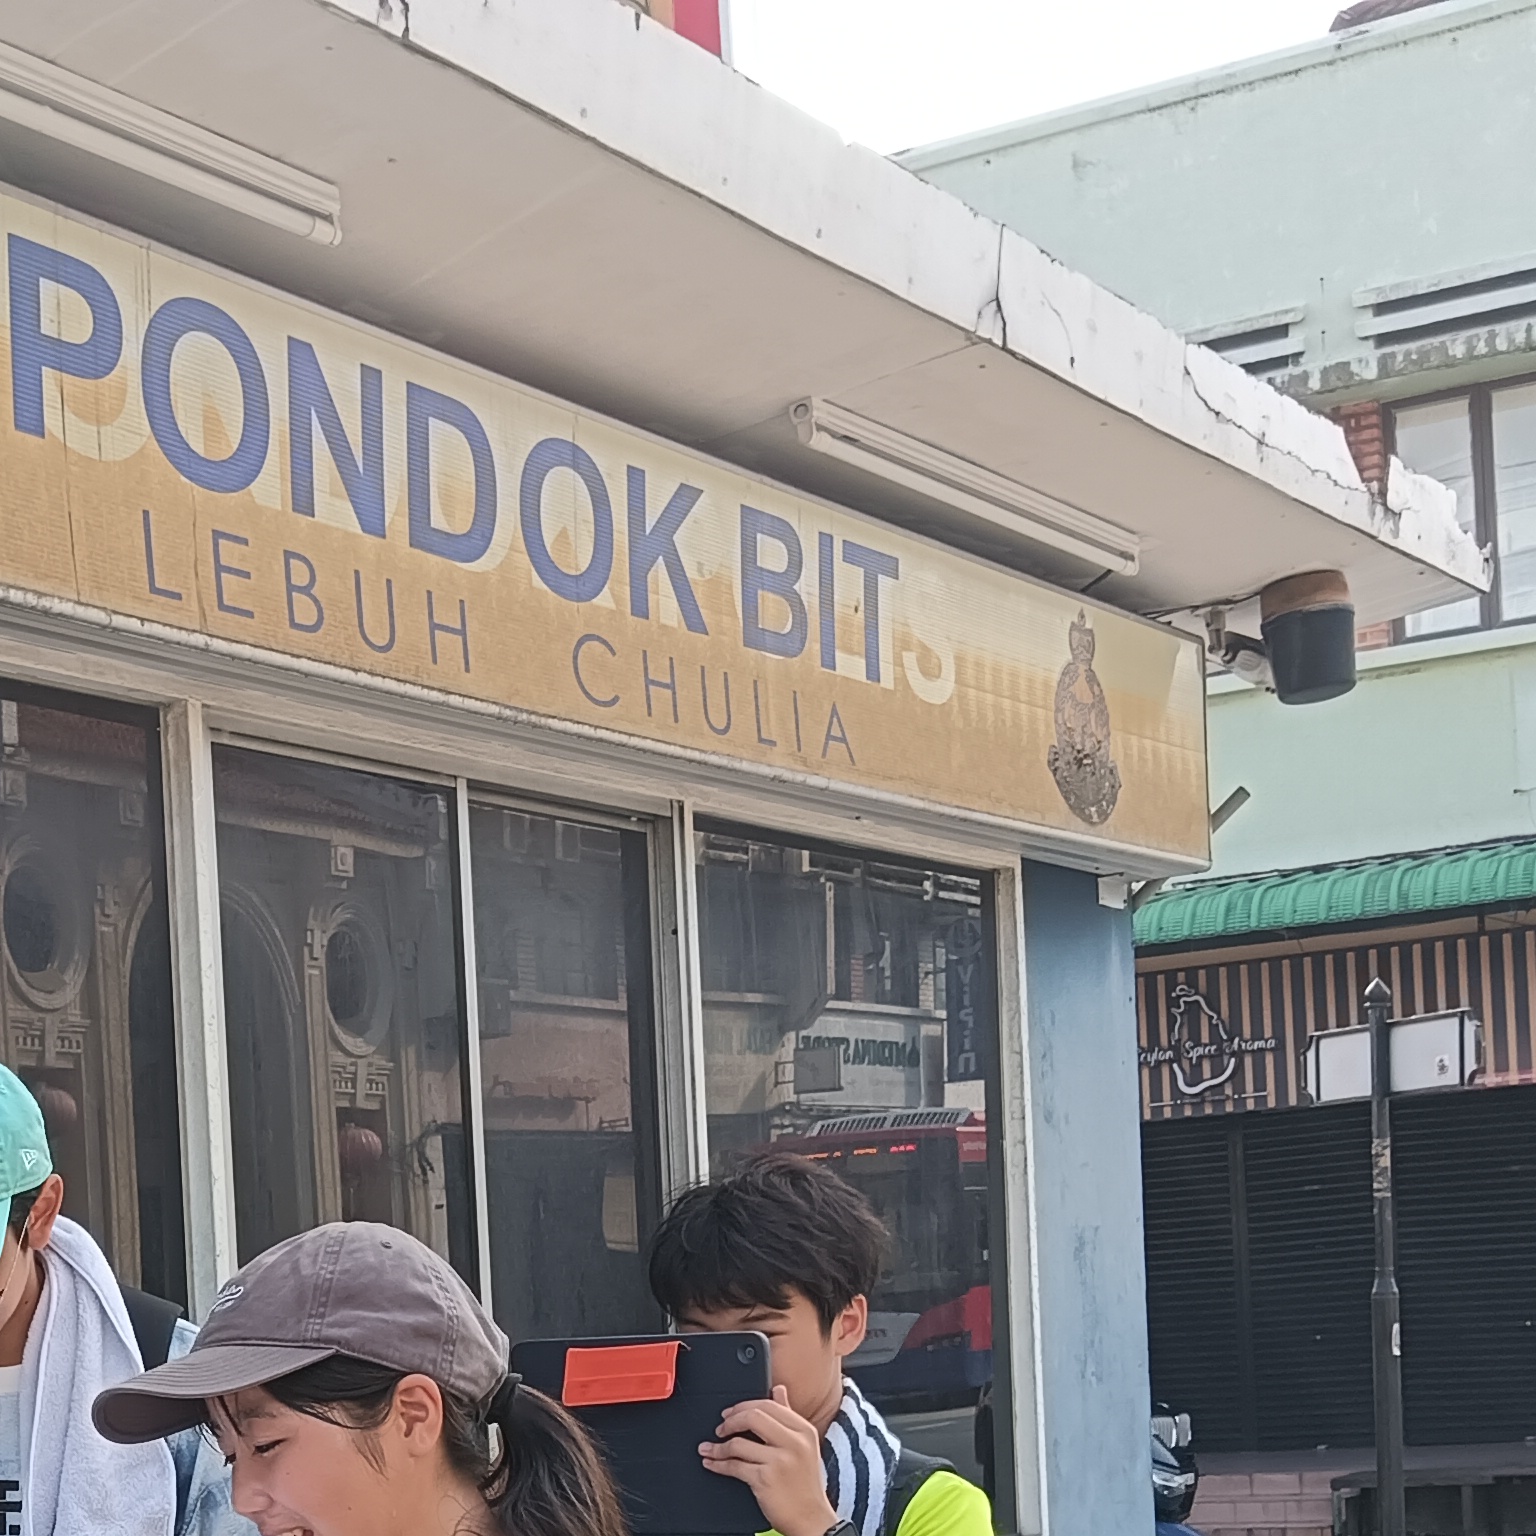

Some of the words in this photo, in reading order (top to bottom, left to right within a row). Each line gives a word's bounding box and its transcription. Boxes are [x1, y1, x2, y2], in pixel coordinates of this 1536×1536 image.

[7, 232, 709, 636] PONDOK
[141, 508, 471, 673] LEBUH
[571, 633, 857, 766] CHULIA
[1138, 1047, 1174, 1067] eylon
[1182, 1041, 1217, 1064] Spice
[1224, 1036, 1276, 1053] Aroma
